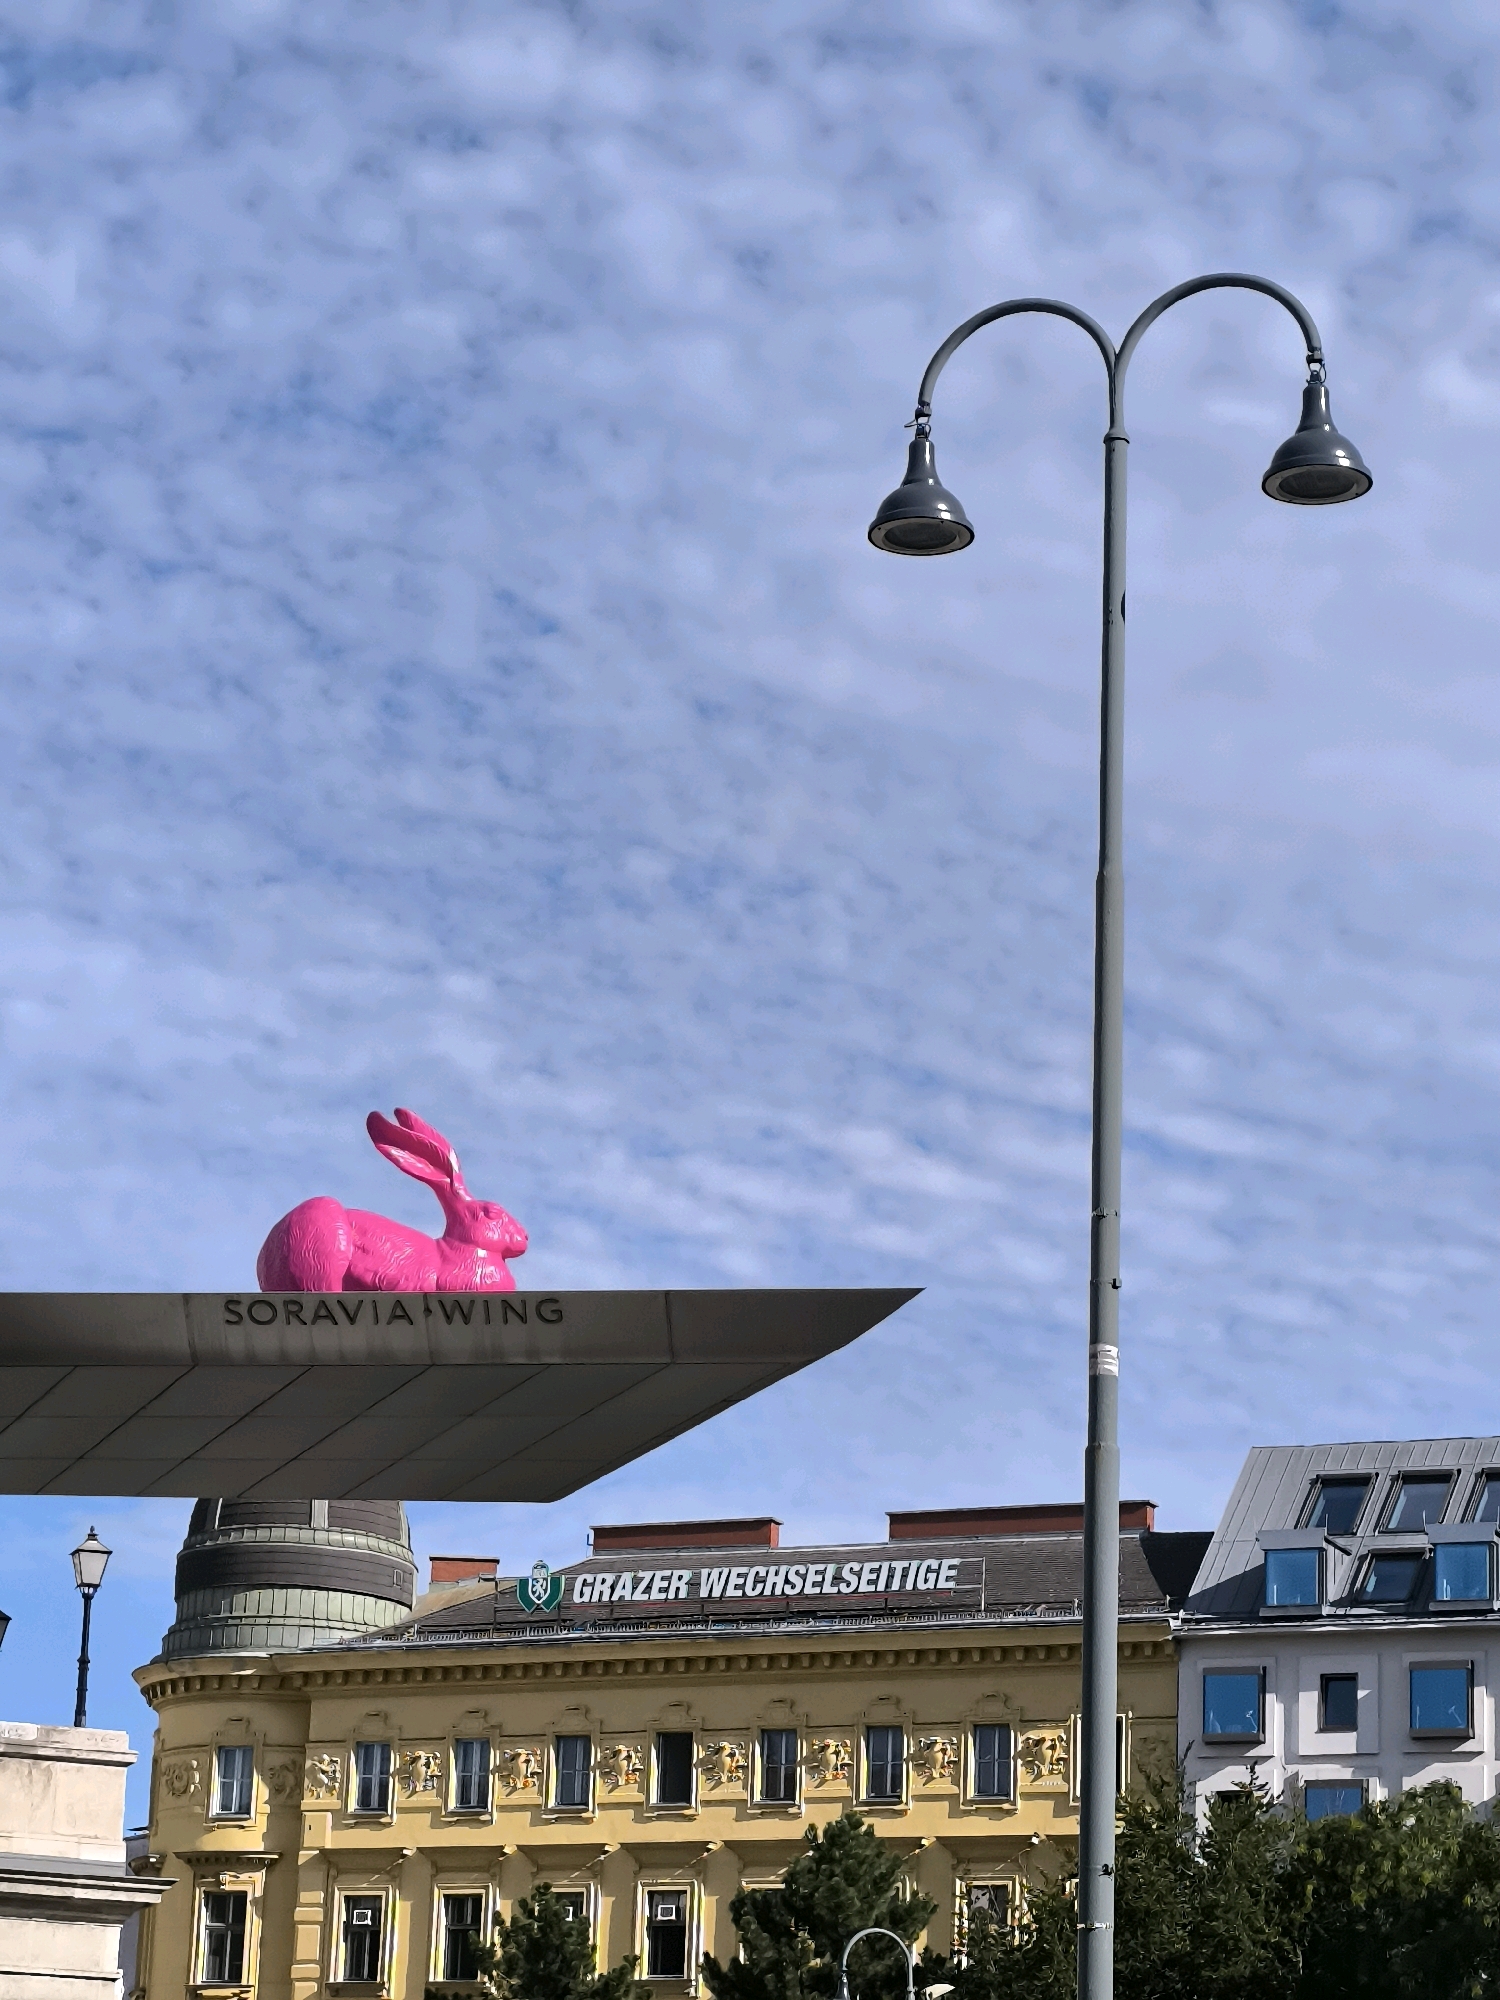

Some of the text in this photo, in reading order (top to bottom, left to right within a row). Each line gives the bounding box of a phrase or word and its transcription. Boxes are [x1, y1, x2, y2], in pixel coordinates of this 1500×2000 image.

[223, 1298, 564, 1326] SORAVIA WING
[573, 1559, 960, 1603] GRAZER WECHSELSEITIGE
